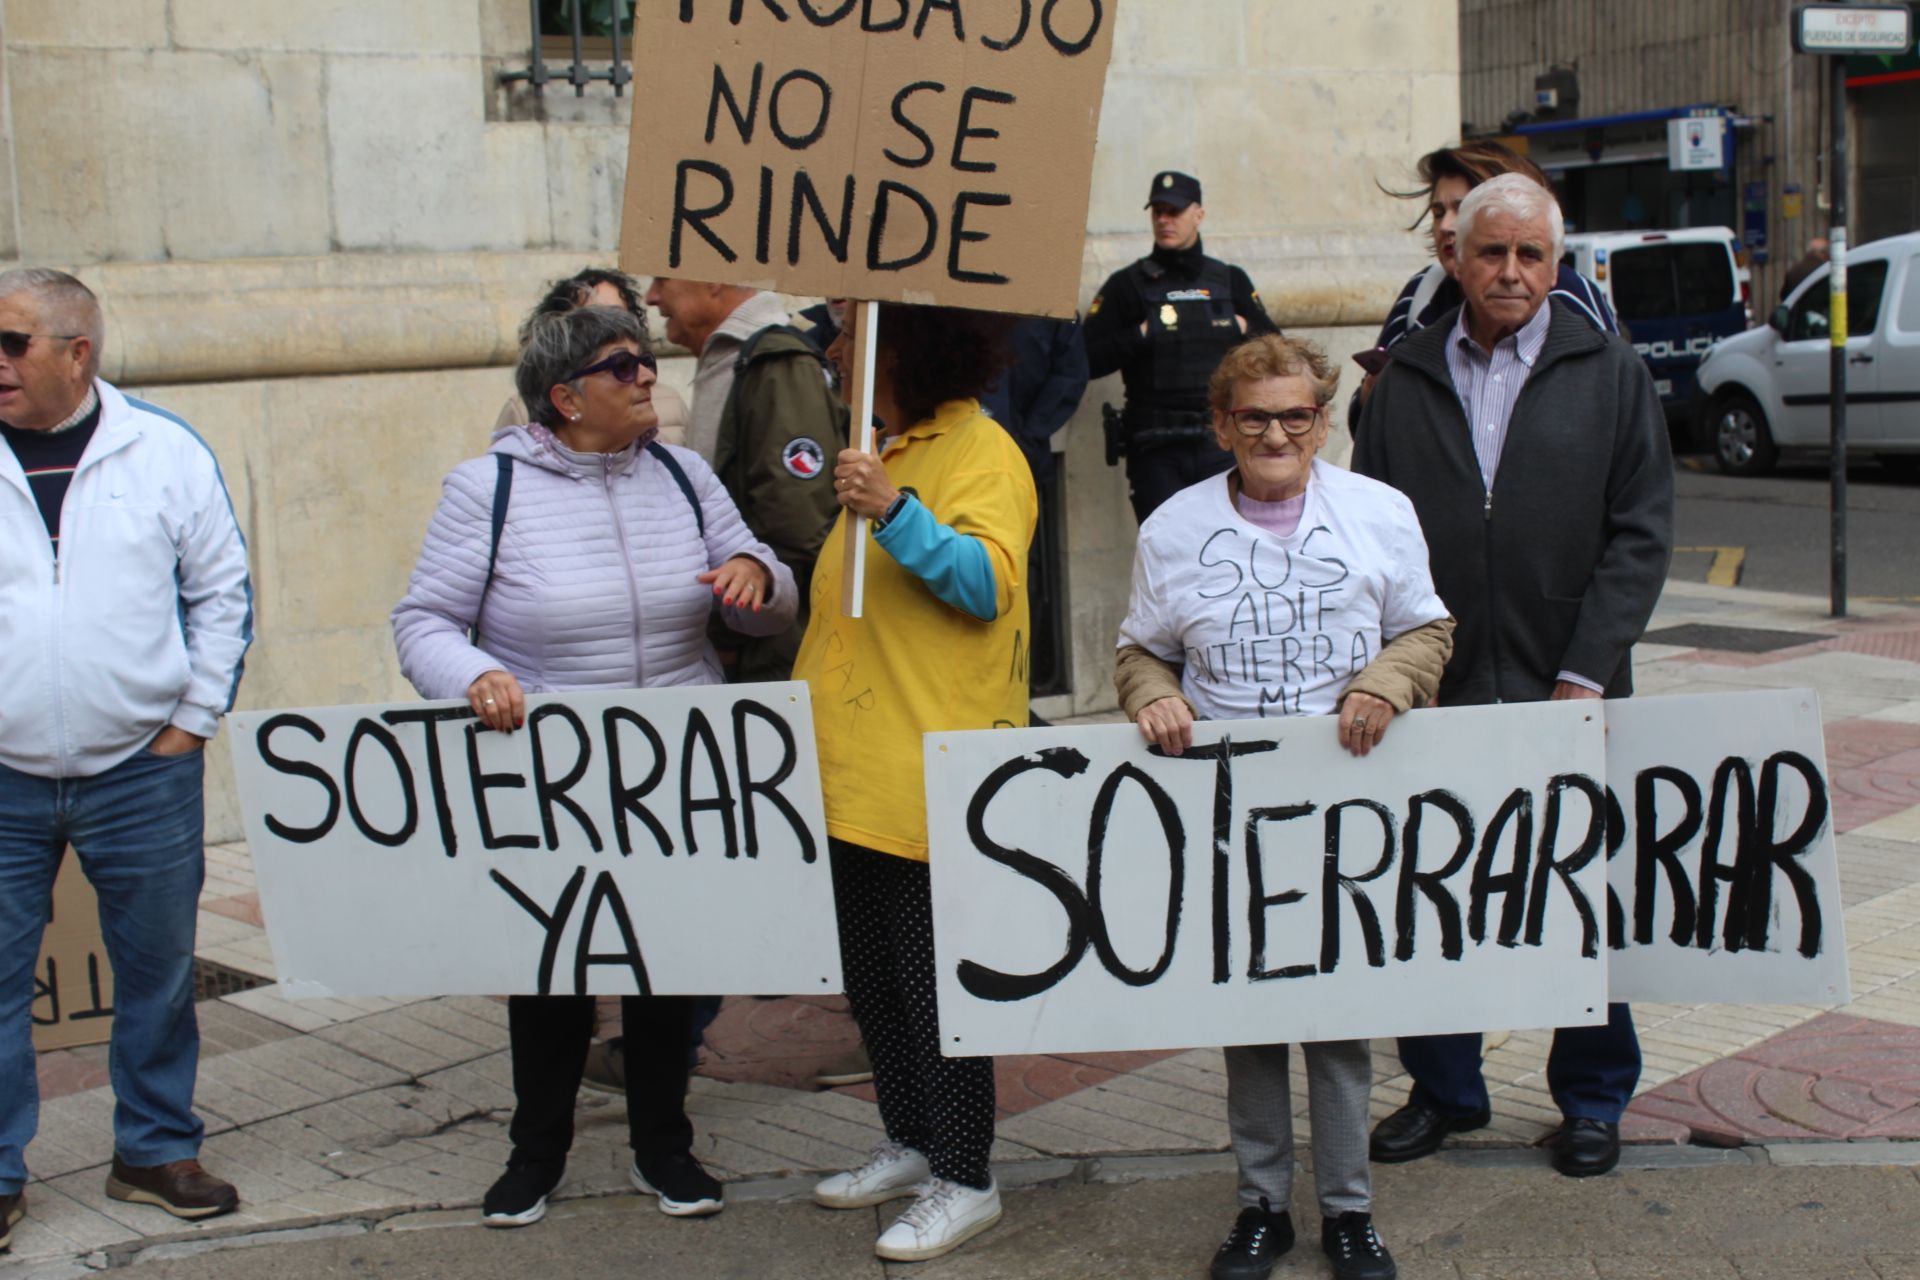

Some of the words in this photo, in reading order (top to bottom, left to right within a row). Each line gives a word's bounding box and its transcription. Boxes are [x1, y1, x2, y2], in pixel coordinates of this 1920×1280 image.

[704, 62, 832, 151] NO
[882, 81, 1016, 173] SE
[669, 159, 1012, 285] RINDE
[1632, 333, 1723, 359] POLIC
[256, 699, 817, 863] SOTERRAR
[488, 866, 652, 996] YA
[956, 732, 1607, 1002] SOTERRAR
